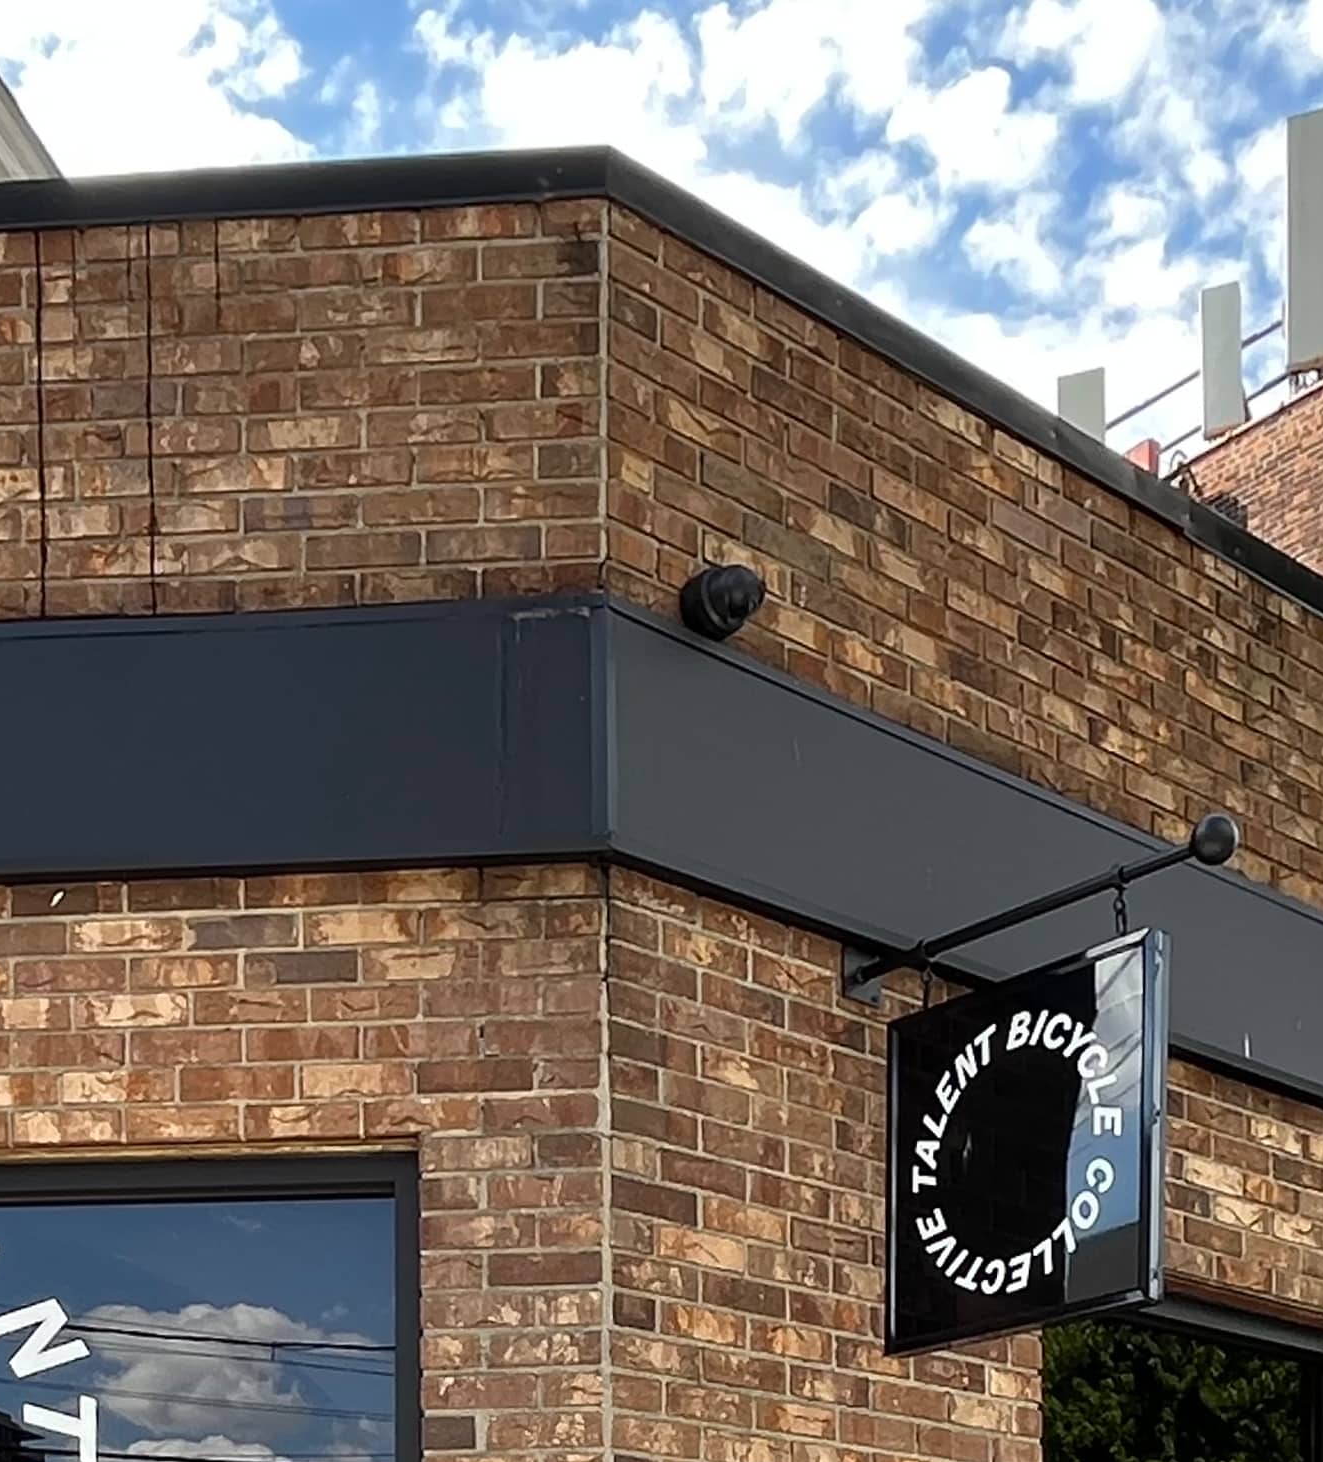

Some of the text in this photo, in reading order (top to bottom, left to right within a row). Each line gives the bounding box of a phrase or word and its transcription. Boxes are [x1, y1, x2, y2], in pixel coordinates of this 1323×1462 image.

[912, 1009, 1124, 1295] TALENT BICYCLE COLLECTIVE
